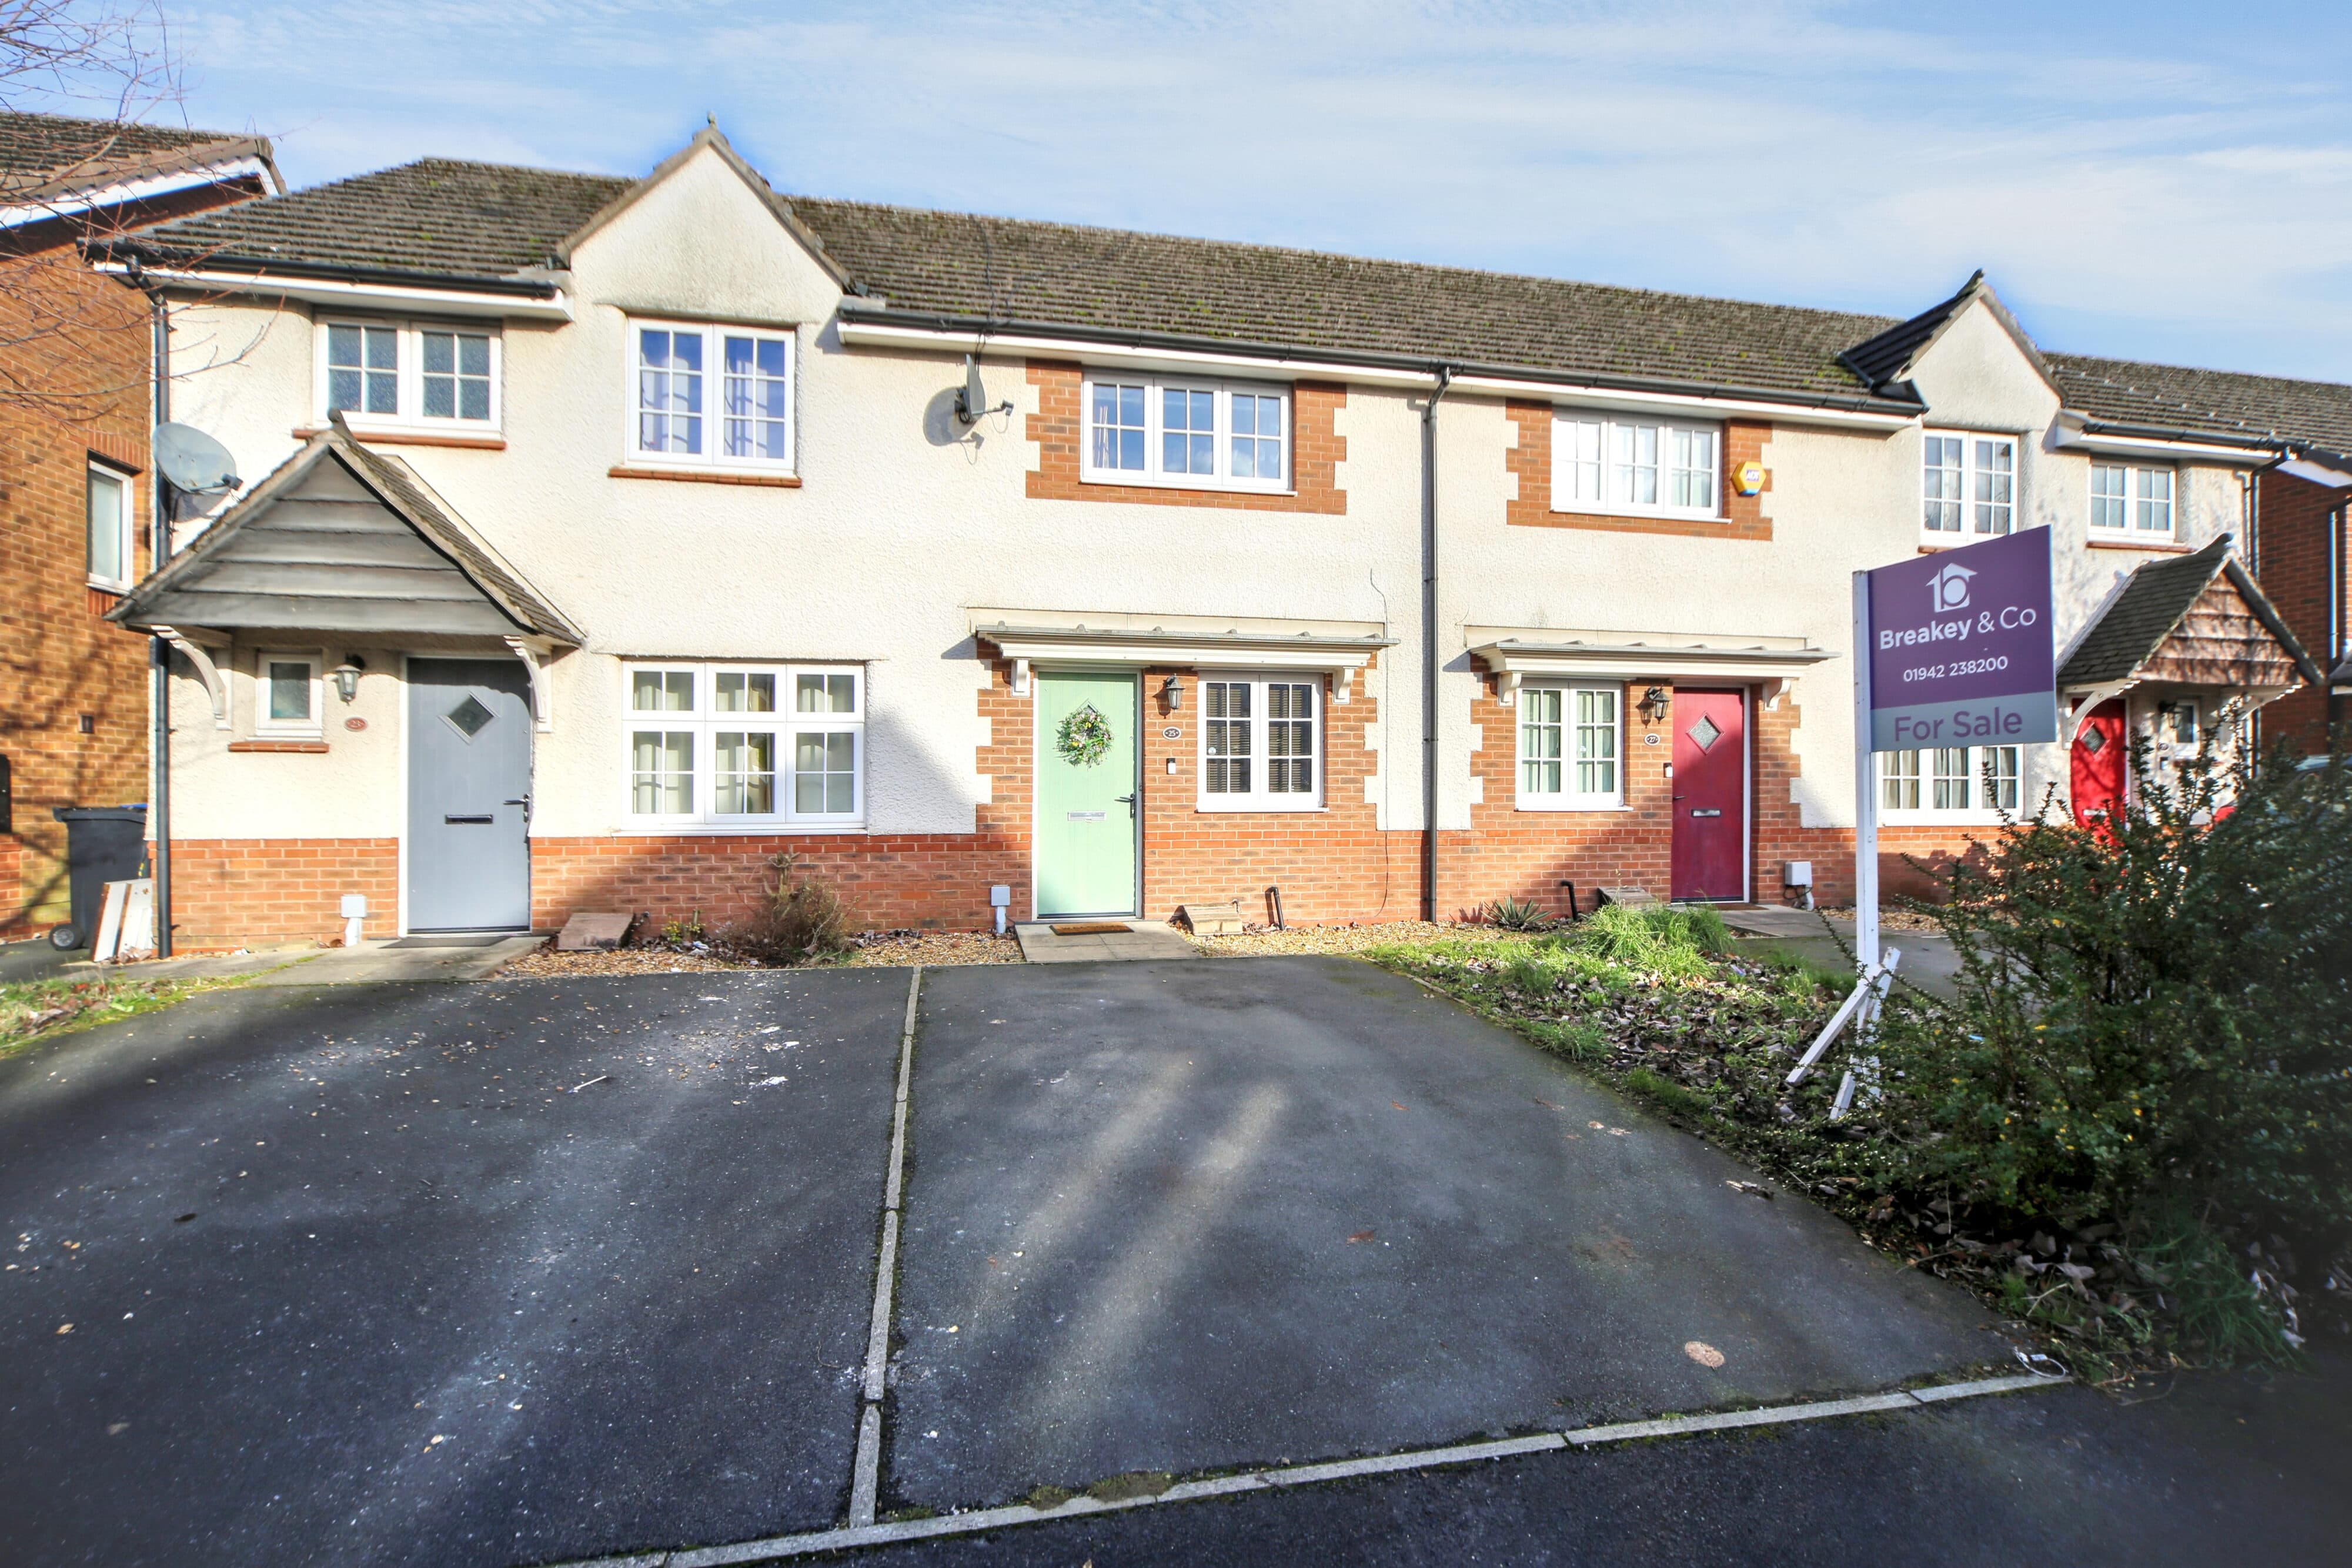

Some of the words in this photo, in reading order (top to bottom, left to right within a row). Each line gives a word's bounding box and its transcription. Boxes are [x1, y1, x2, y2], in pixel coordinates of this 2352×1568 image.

[1880, 618, 1972, 650] Breakey
[1977, 611, 1994, 634] &
[2000, 606, 2036, 629] Co
[1903, 664, 1945, 682] 01942
[1949, 656, 2008, 677] 238200
[1895, 716, 1944, 741] For
[1953, 707, 2023, 738] Sale
